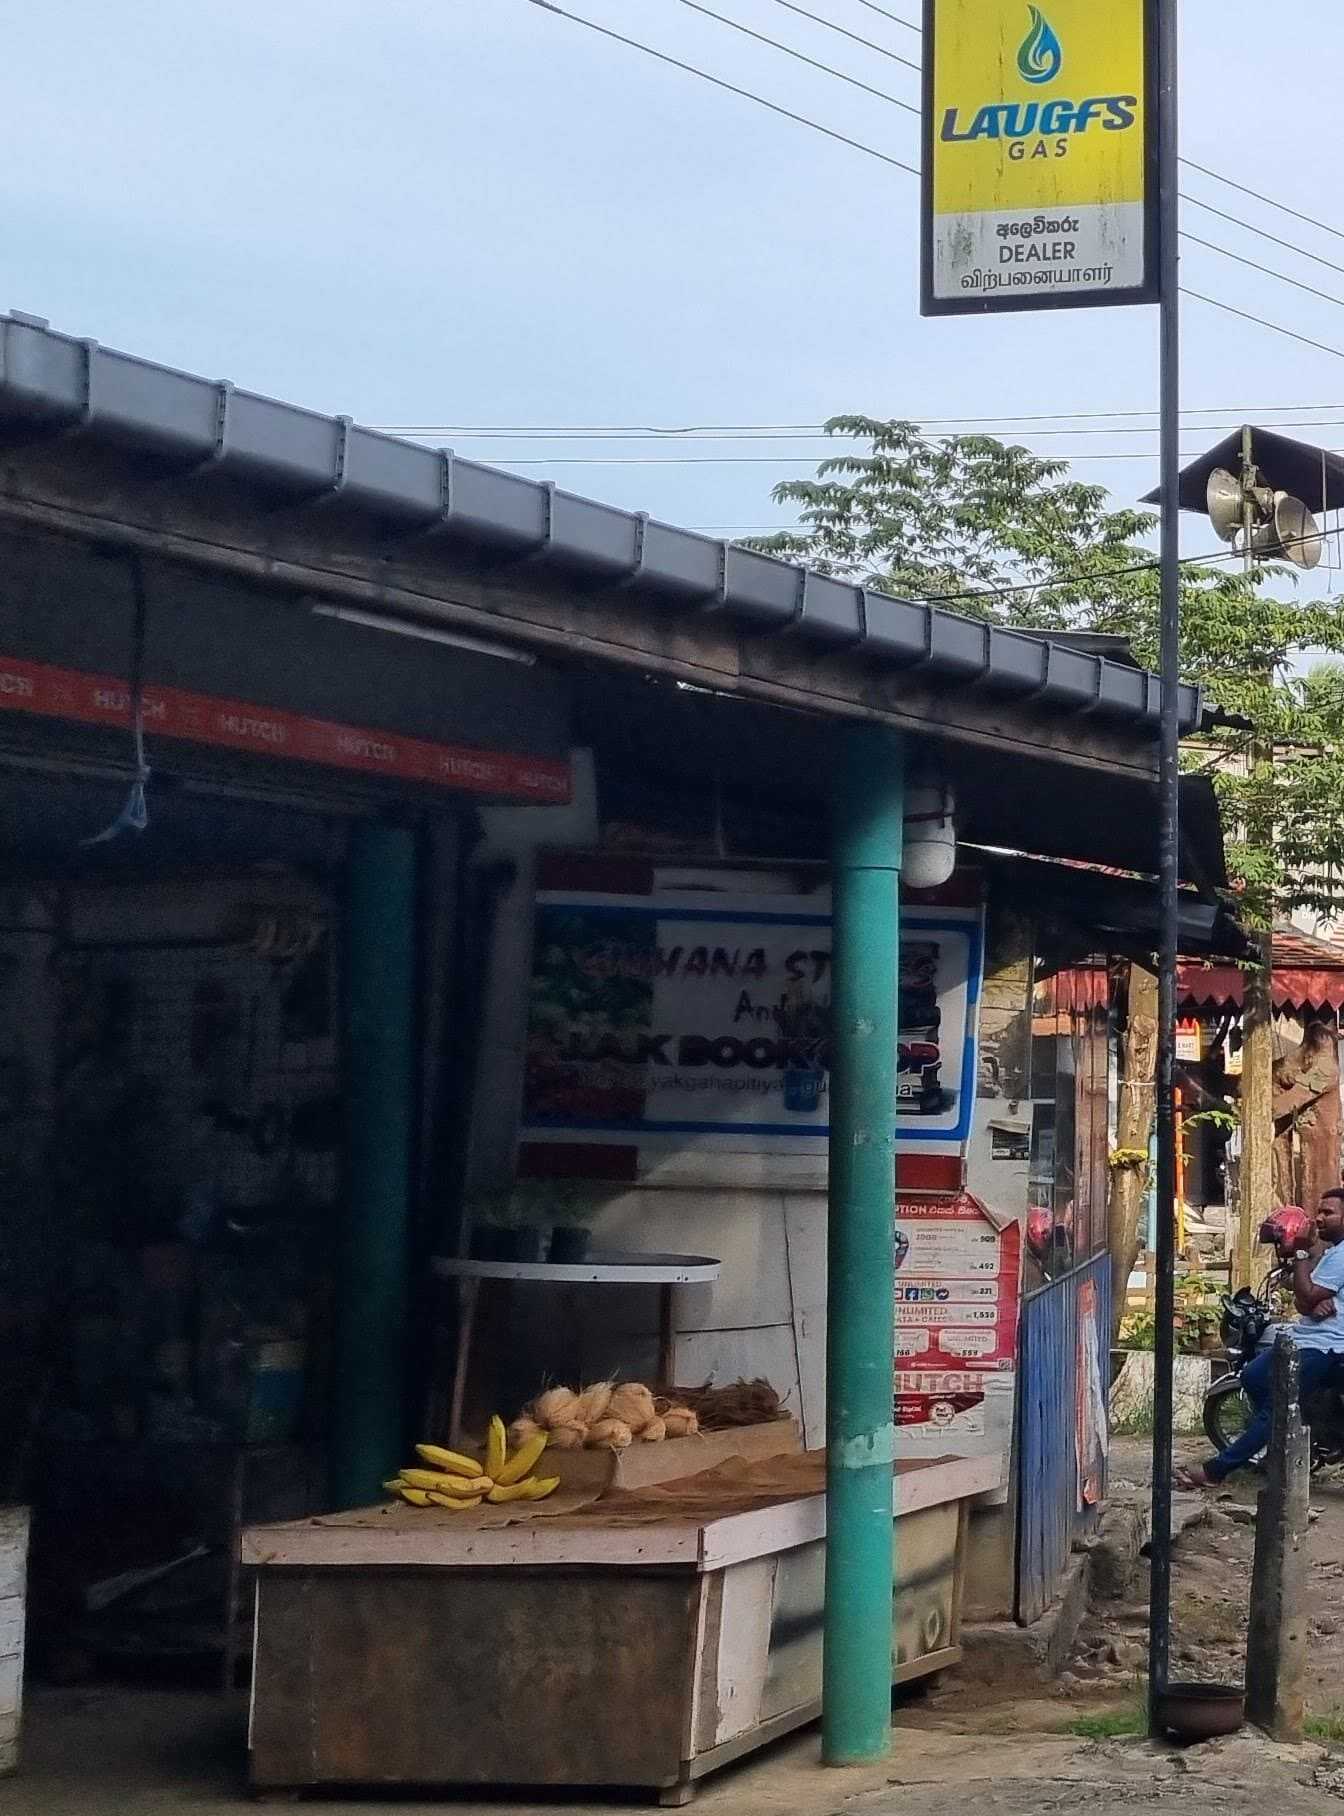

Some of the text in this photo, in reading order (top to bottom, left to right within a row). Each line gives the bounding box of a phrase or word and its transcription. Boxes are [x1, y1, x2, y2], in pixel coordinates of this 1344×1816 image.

[940, 95, 1137, 142] LAUGFS
[1008, 138, 1068, 160] GAS
[1000, 242, 1075, 264] DEALER
[961, 262, 1113, 291] விற்பனையாளர்
[93, 690, 165, 720] HUCH
